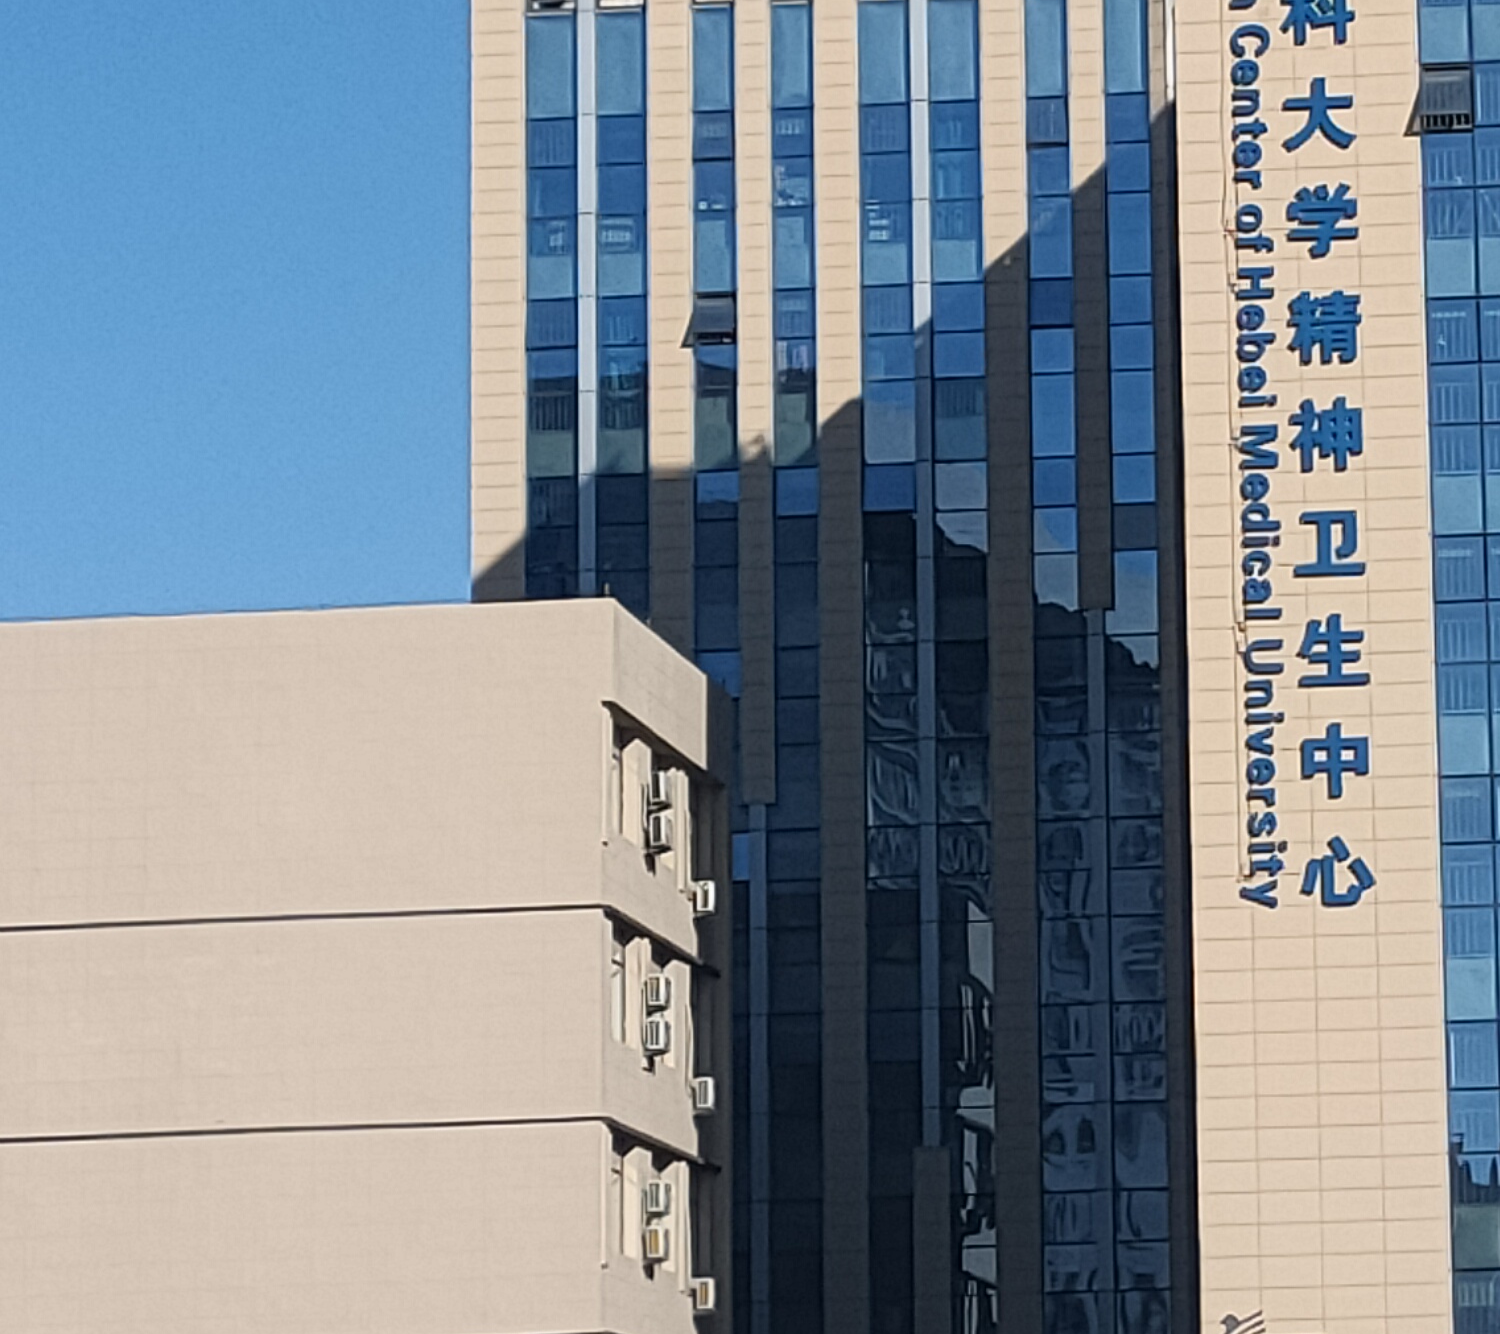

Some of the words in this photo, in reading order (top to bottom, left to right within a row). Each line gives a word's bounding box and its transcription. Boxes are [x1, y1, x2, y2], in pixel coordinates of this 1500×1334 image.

[1228, 21, 1272, 191] Center
[1233, 202, 1275, 253] of
[1234, 265, 1278, 408] Hebei
[1237, 422, 1283, 621] Medical
[1242, 637, 1287, 910] University
